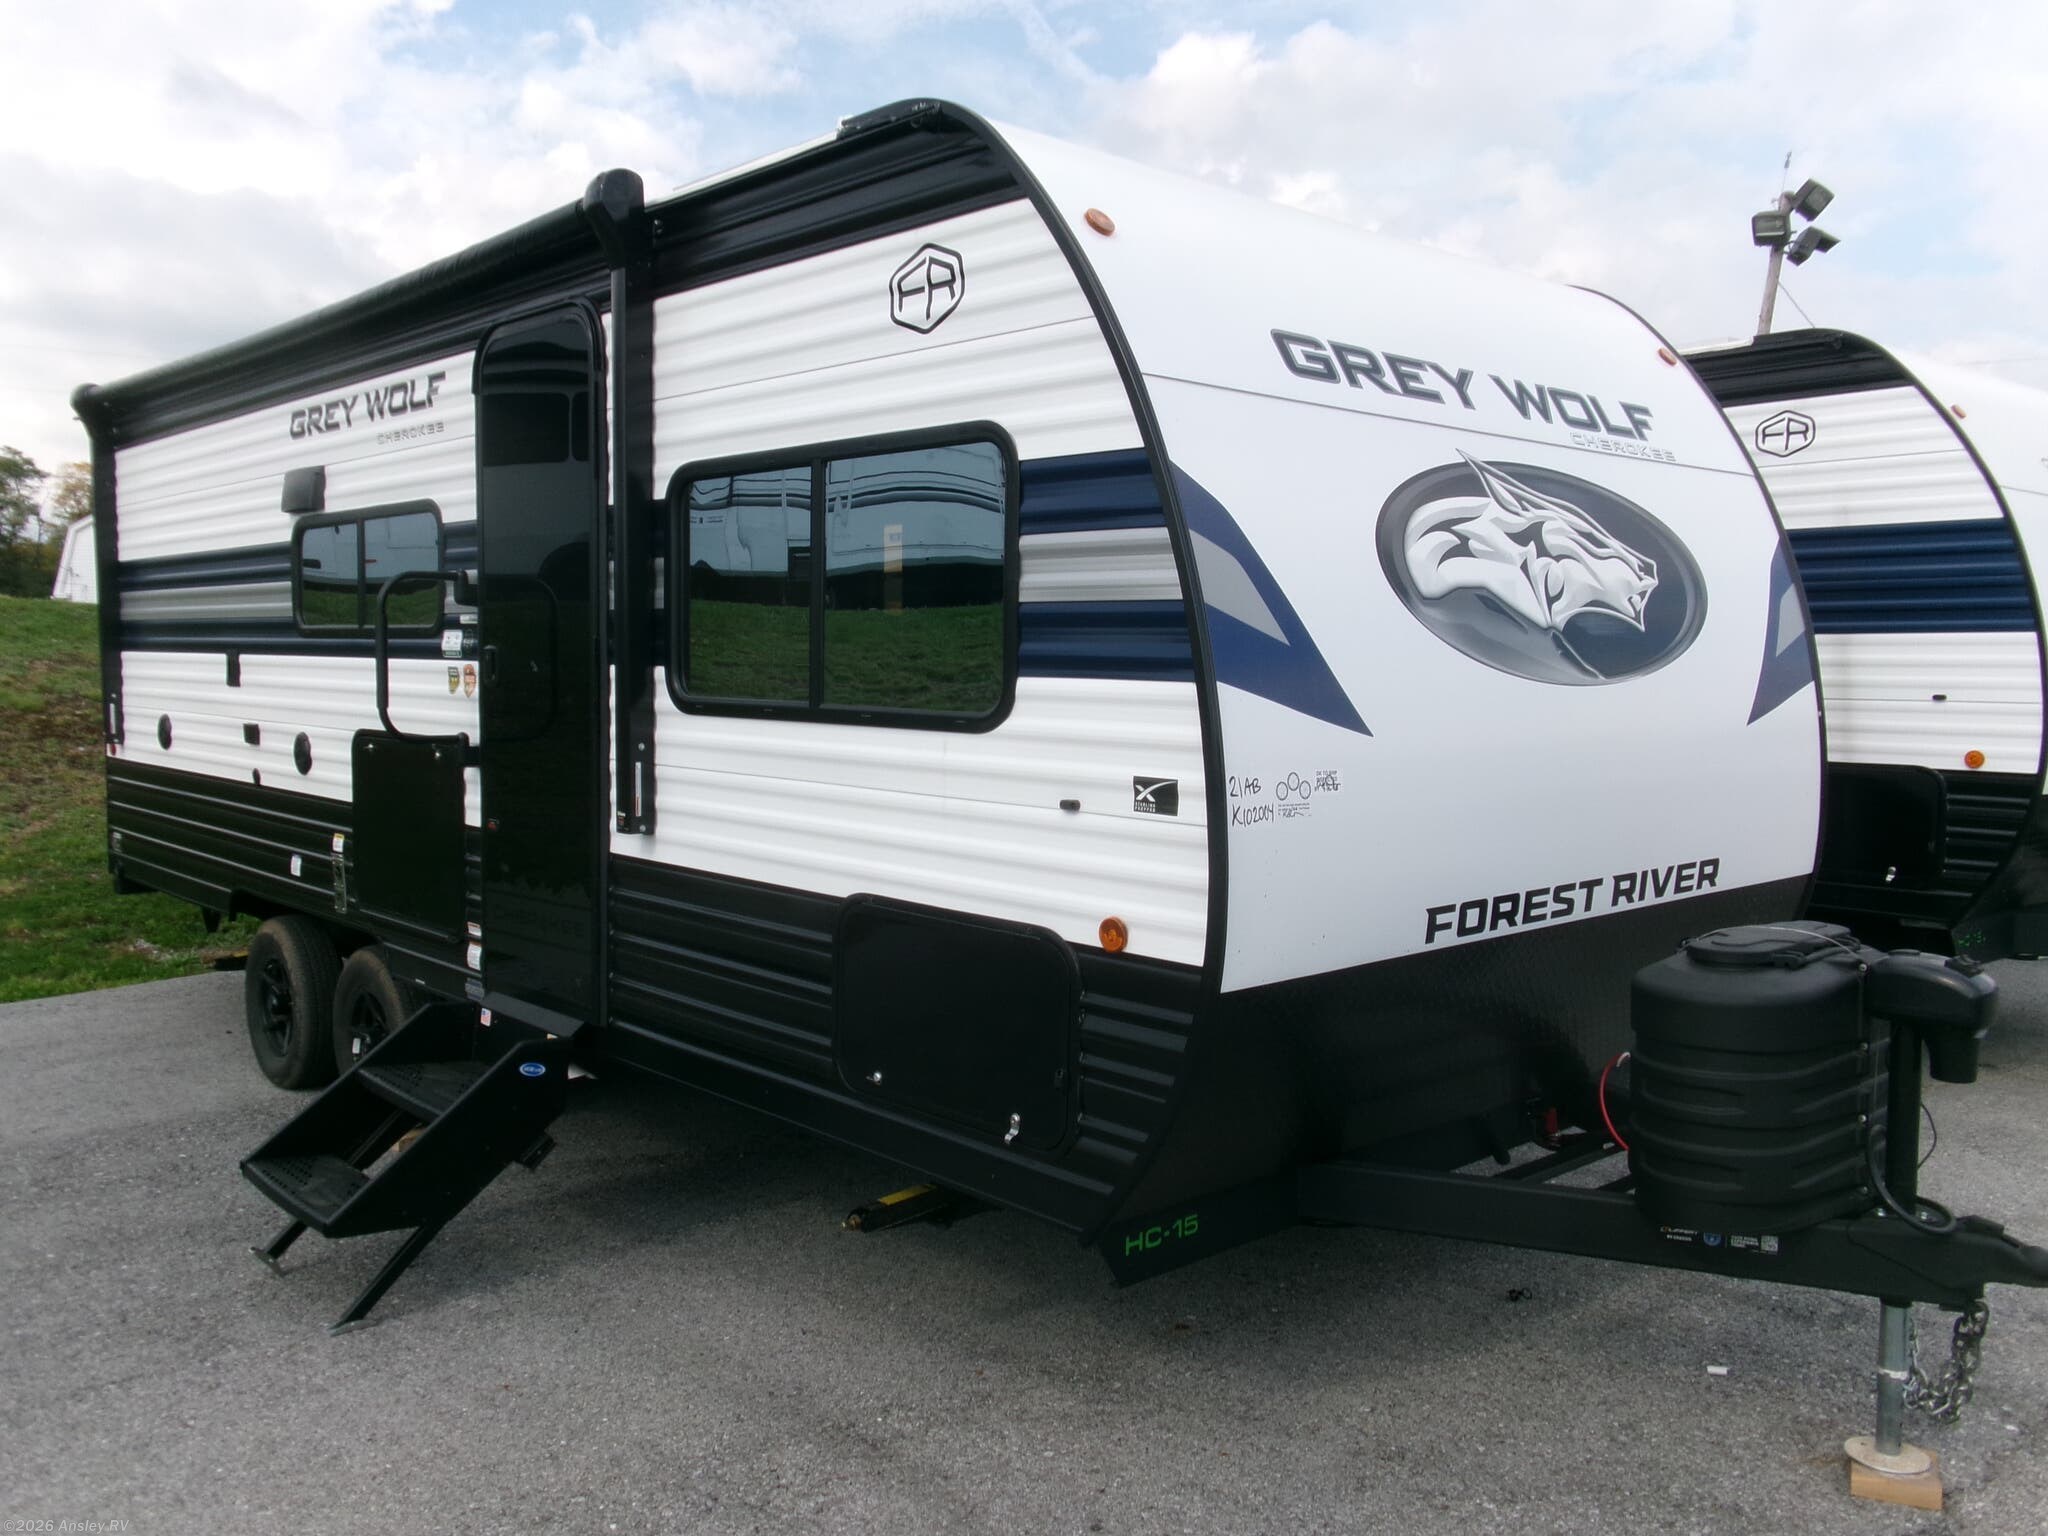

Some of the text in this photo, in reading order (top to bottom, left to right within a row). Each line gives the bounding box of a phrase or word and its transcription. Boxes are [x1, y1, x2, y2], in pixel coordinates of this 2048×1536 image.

[289, 370, 446, 441] GREY WOLF
[1270, 328, 1654, 441] GREY WOLF
[376, 421, 446, 446] CHEROKEE
[1570, 432, 1677, 462] CHEROKEE
[1425, 858, 1720, 945] FOREST RIVER
